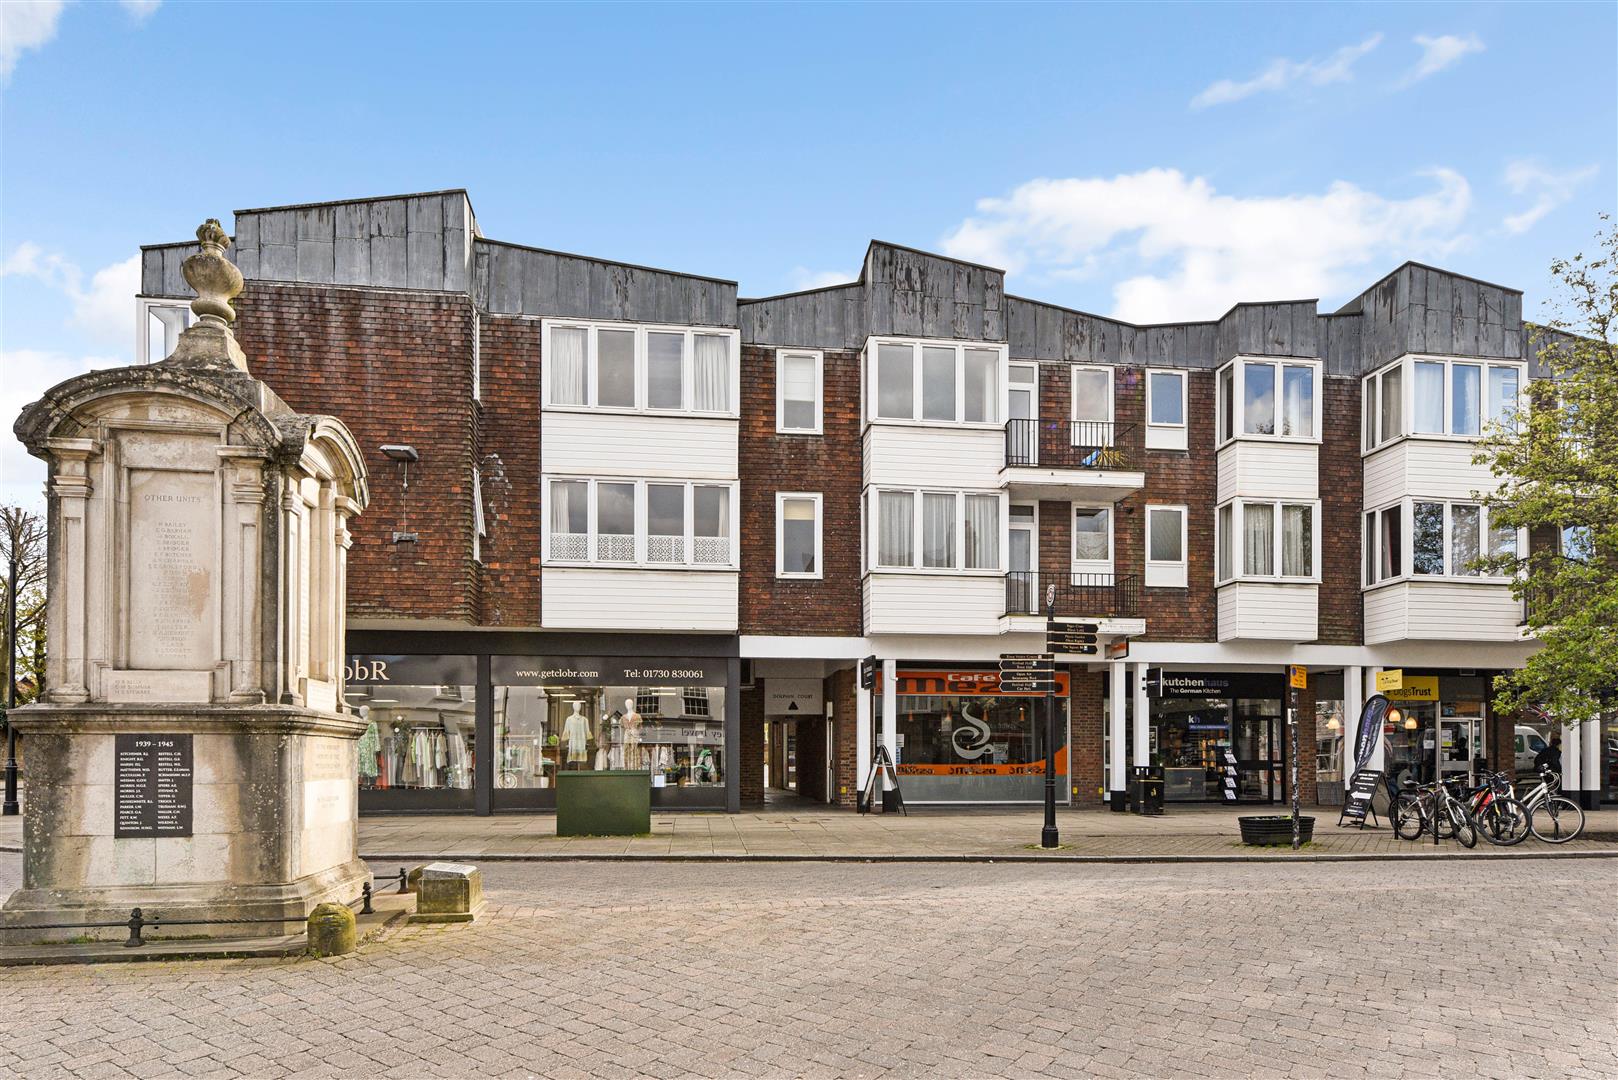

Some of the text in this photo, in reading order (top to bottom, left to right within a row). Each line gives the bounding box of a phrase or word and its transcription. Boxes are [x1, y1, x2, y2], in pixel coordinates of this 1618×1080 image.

[144, 494, 201, 503] OTHER UNITS
[516, 669, 599, 678] www.getclobr.com
[624, 669, 704, 678] Tel: 01730 830061
[1162, 677, 1229, 687] kutchenhaus
